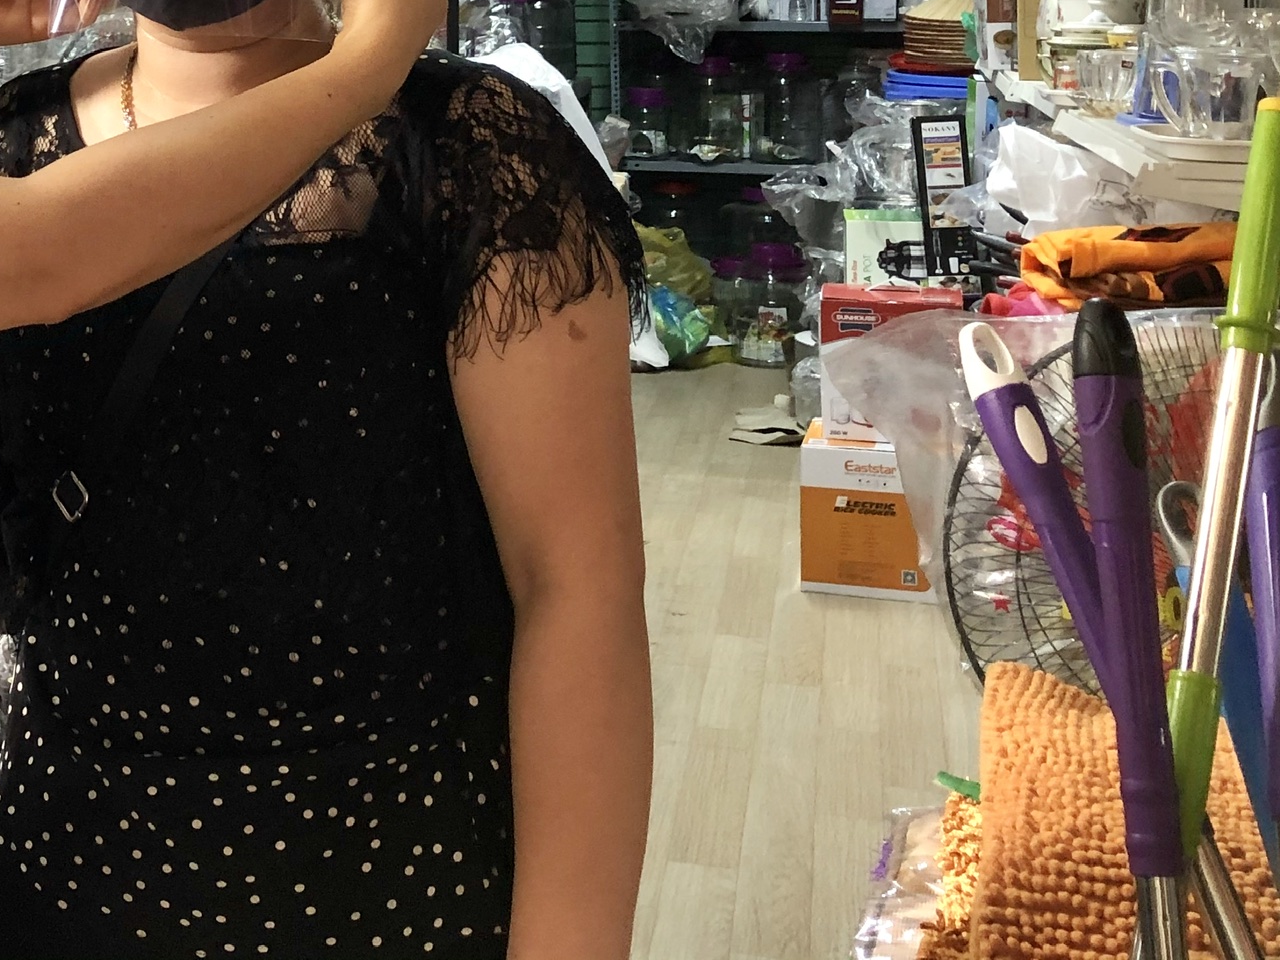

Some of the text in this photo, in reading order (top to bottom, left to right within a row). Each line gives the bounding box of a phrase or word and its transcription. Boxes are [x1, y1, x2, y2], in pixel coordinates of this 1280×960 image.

[835, 314, 878, 322] SUNHOUSE
[844, 460, 896, 475] Eaststar
[833, 506, 896, 517] RICE COOKER
